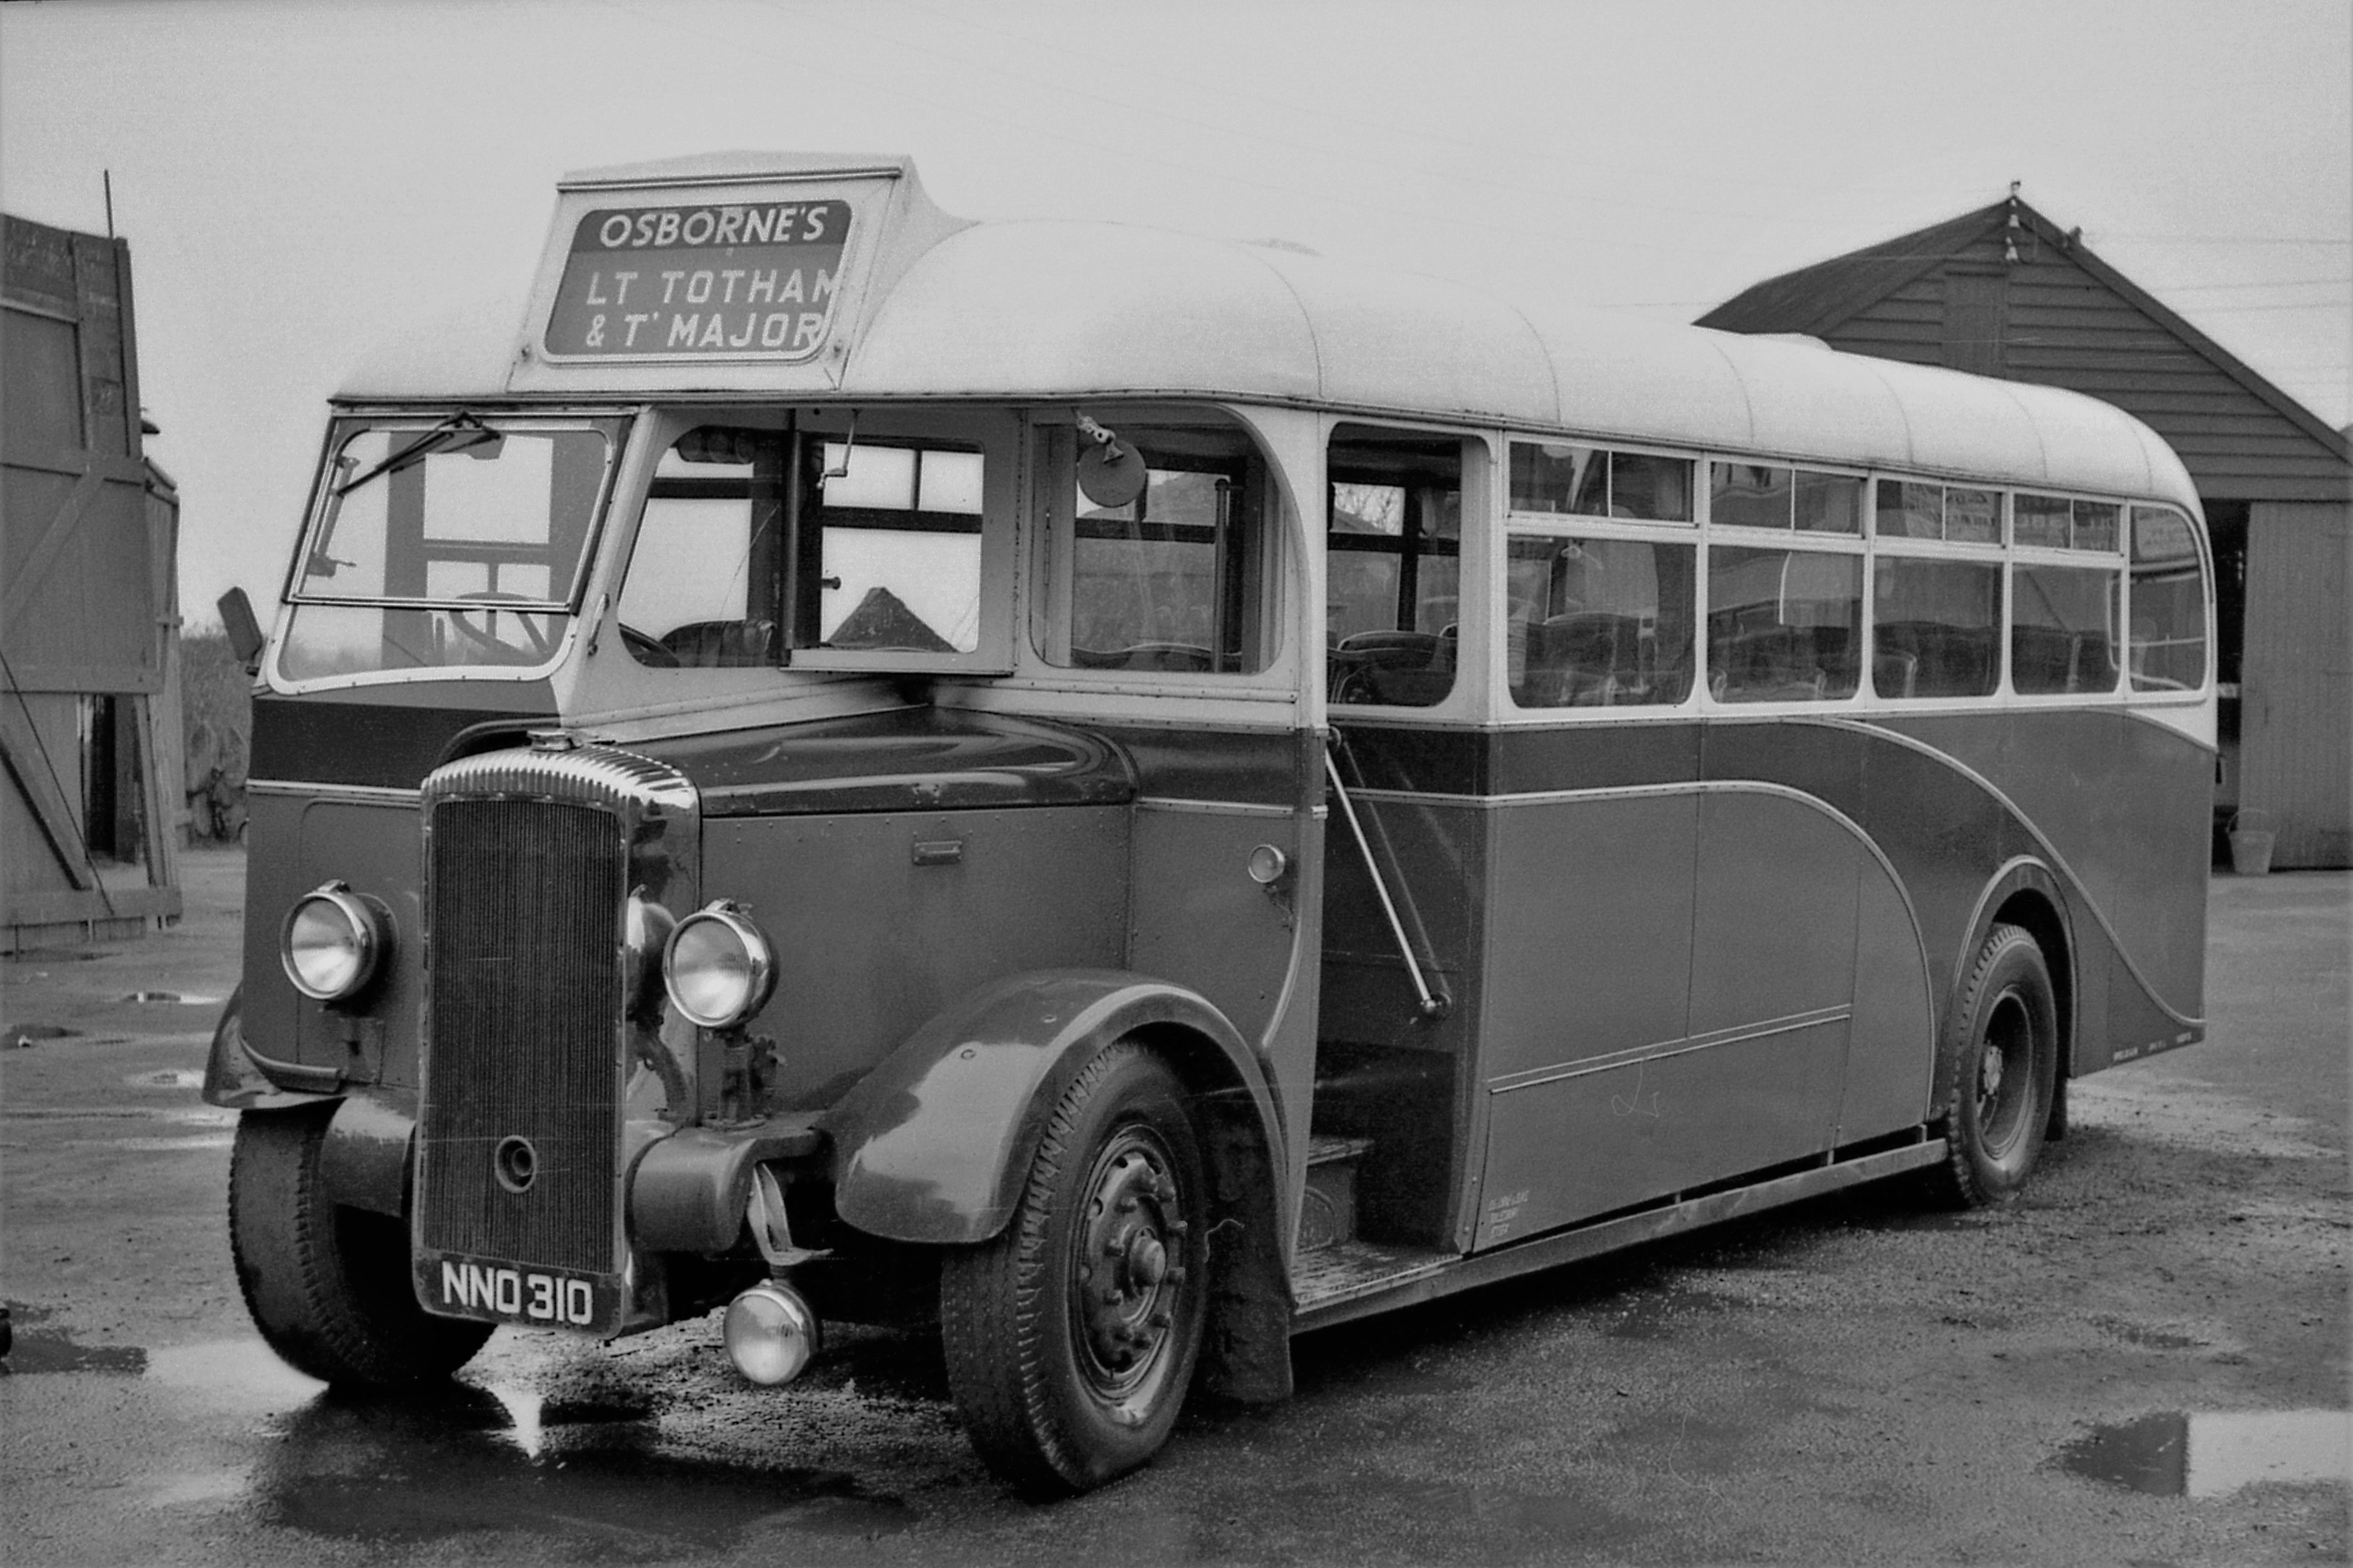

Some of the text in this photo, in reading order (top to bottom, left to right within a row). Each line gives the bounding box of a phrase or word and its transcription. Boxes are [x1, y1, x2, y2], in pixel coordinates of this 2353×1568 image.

[600, 206, 828, 247] OSBORNE'S
[586, 272, 638, 305] LT
[586, 315, 606, 347] &
[442, 1261, 593, 1325] NNO 310
